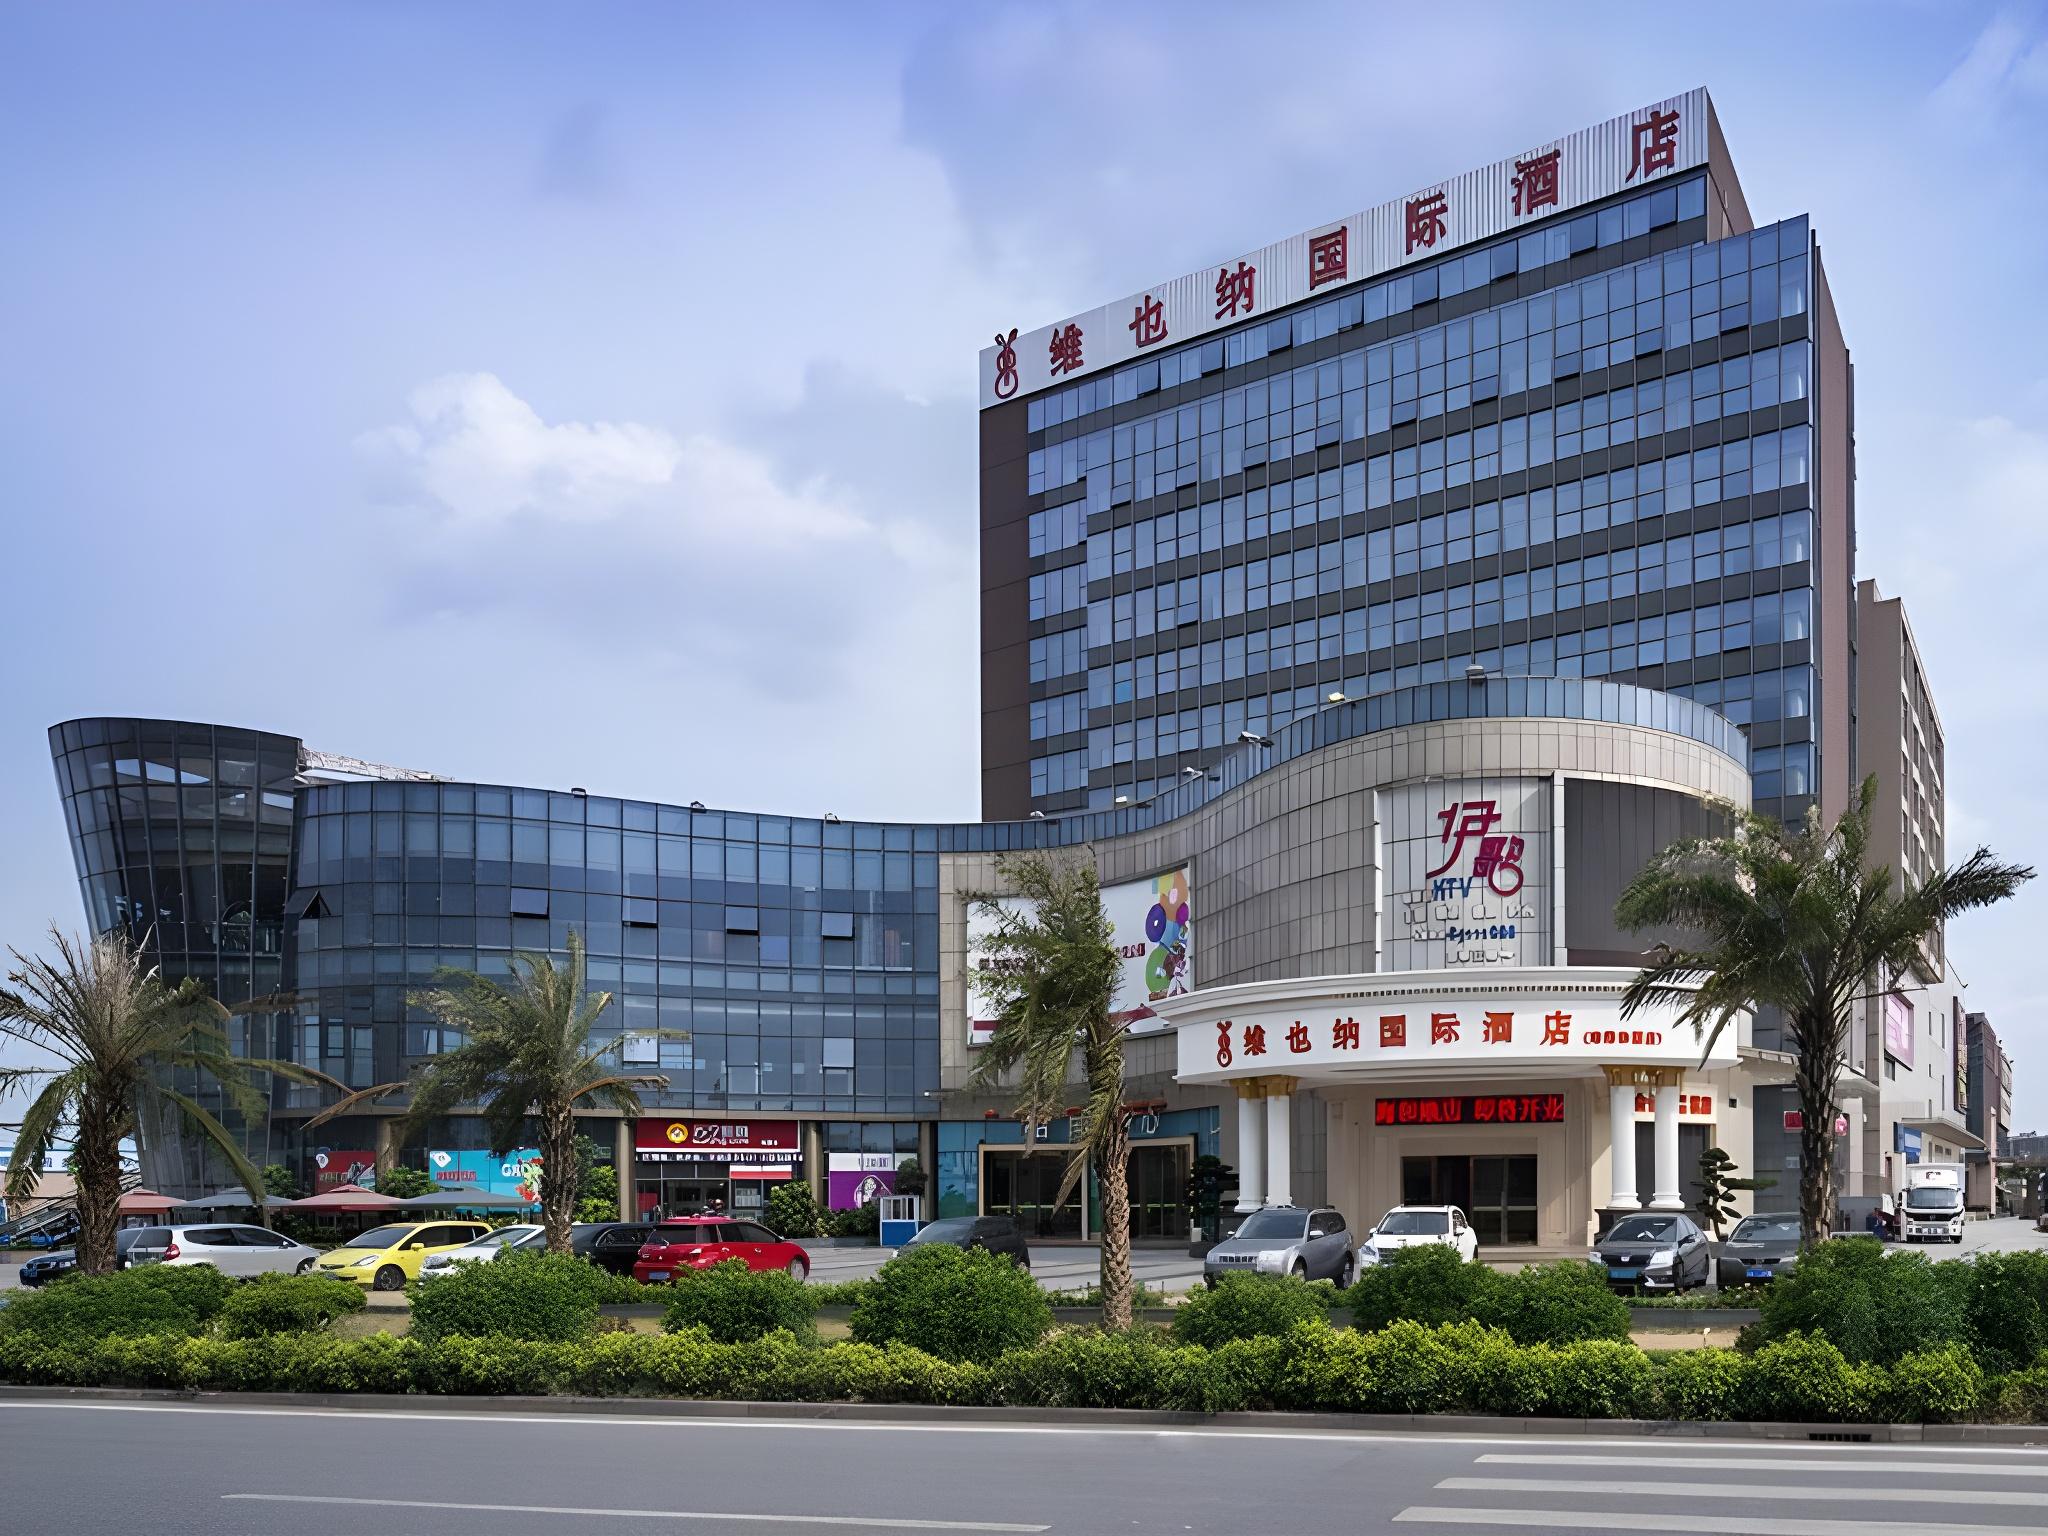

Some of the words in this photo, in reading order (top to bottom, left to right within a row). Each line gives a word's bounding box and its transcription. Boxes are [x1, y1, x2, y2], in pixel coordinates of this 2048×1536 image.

[1049, 110, 1680, 376] 维也纳国际酒店
[1433, 876, 1473, 900] KTV
